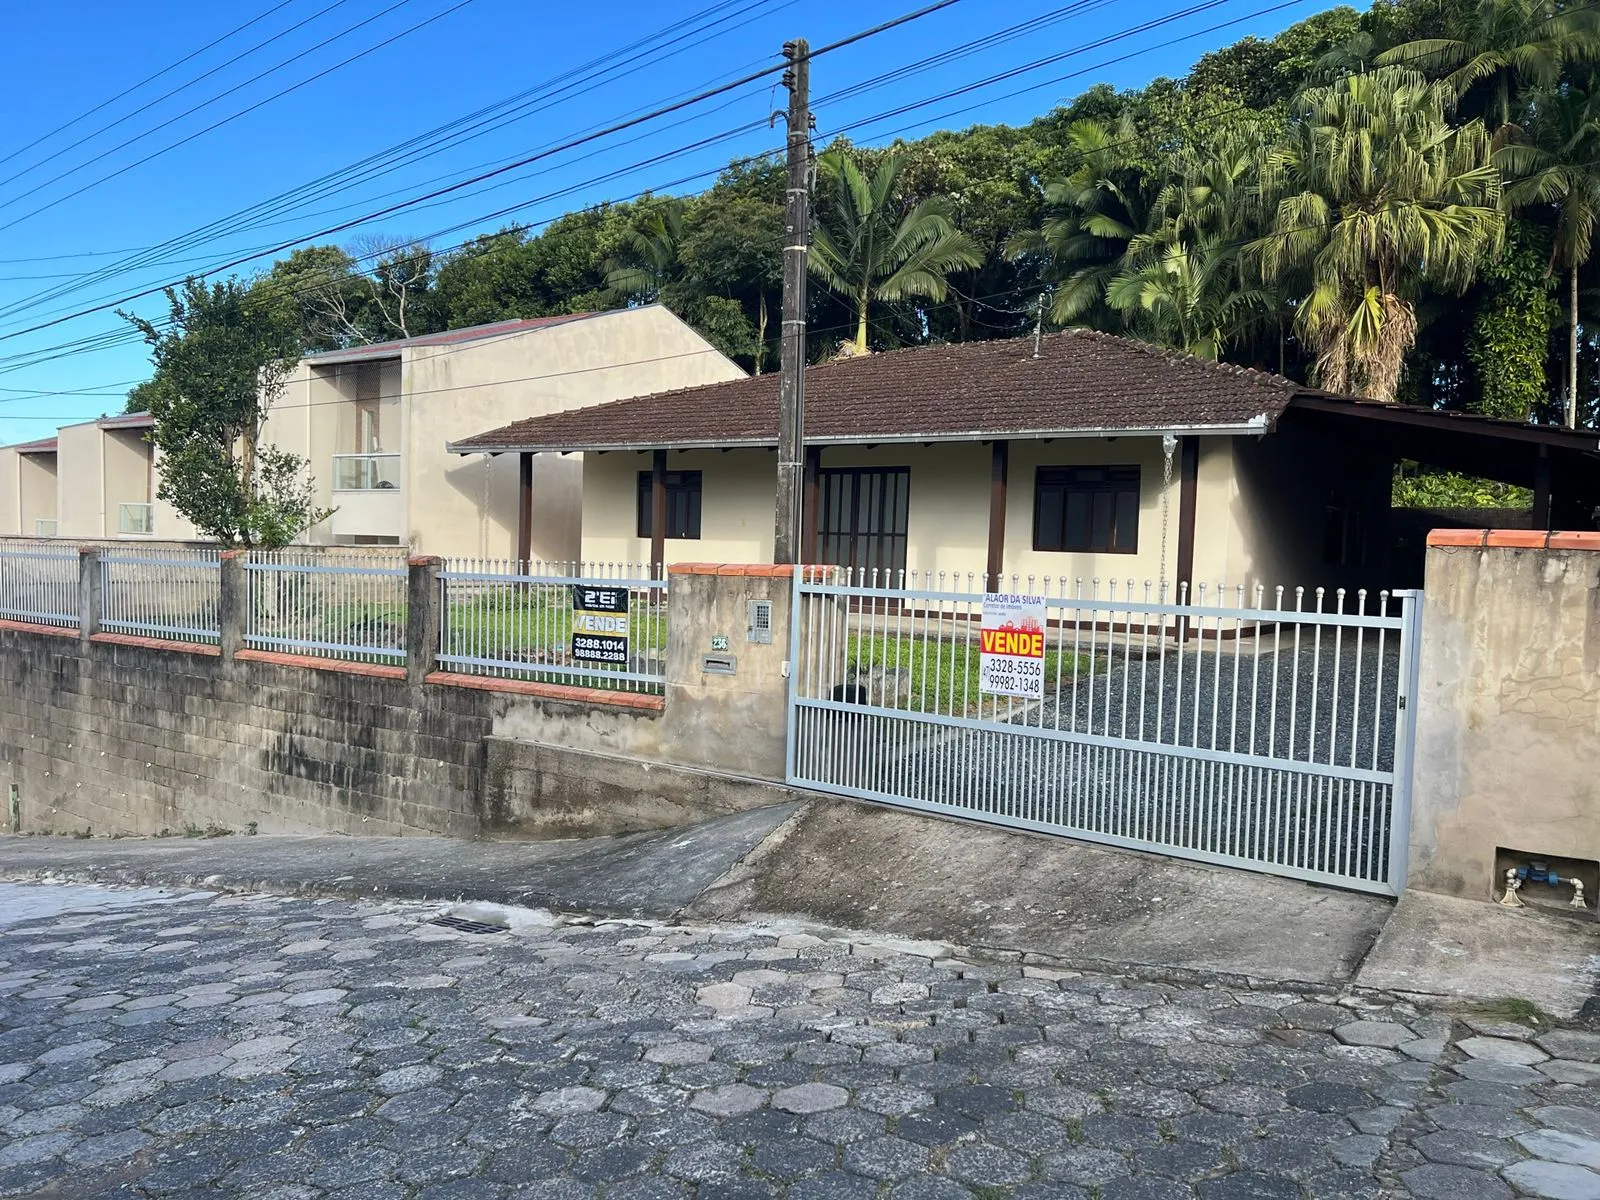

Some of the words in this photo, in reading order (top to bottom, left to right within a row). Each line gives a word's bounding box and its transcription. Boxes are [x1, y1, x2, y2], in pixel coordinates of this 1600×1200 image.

[1010, 595, 1021, 604] DA
[577, 615, 626, 633] VENDE
[575, 638, 624, 650] 3288.1014
[983, 631, 1042, 656] VENDE
[990, 658, 1041, 676] 3328-5556
[989, 674, 1040, 693] 99982-1348
